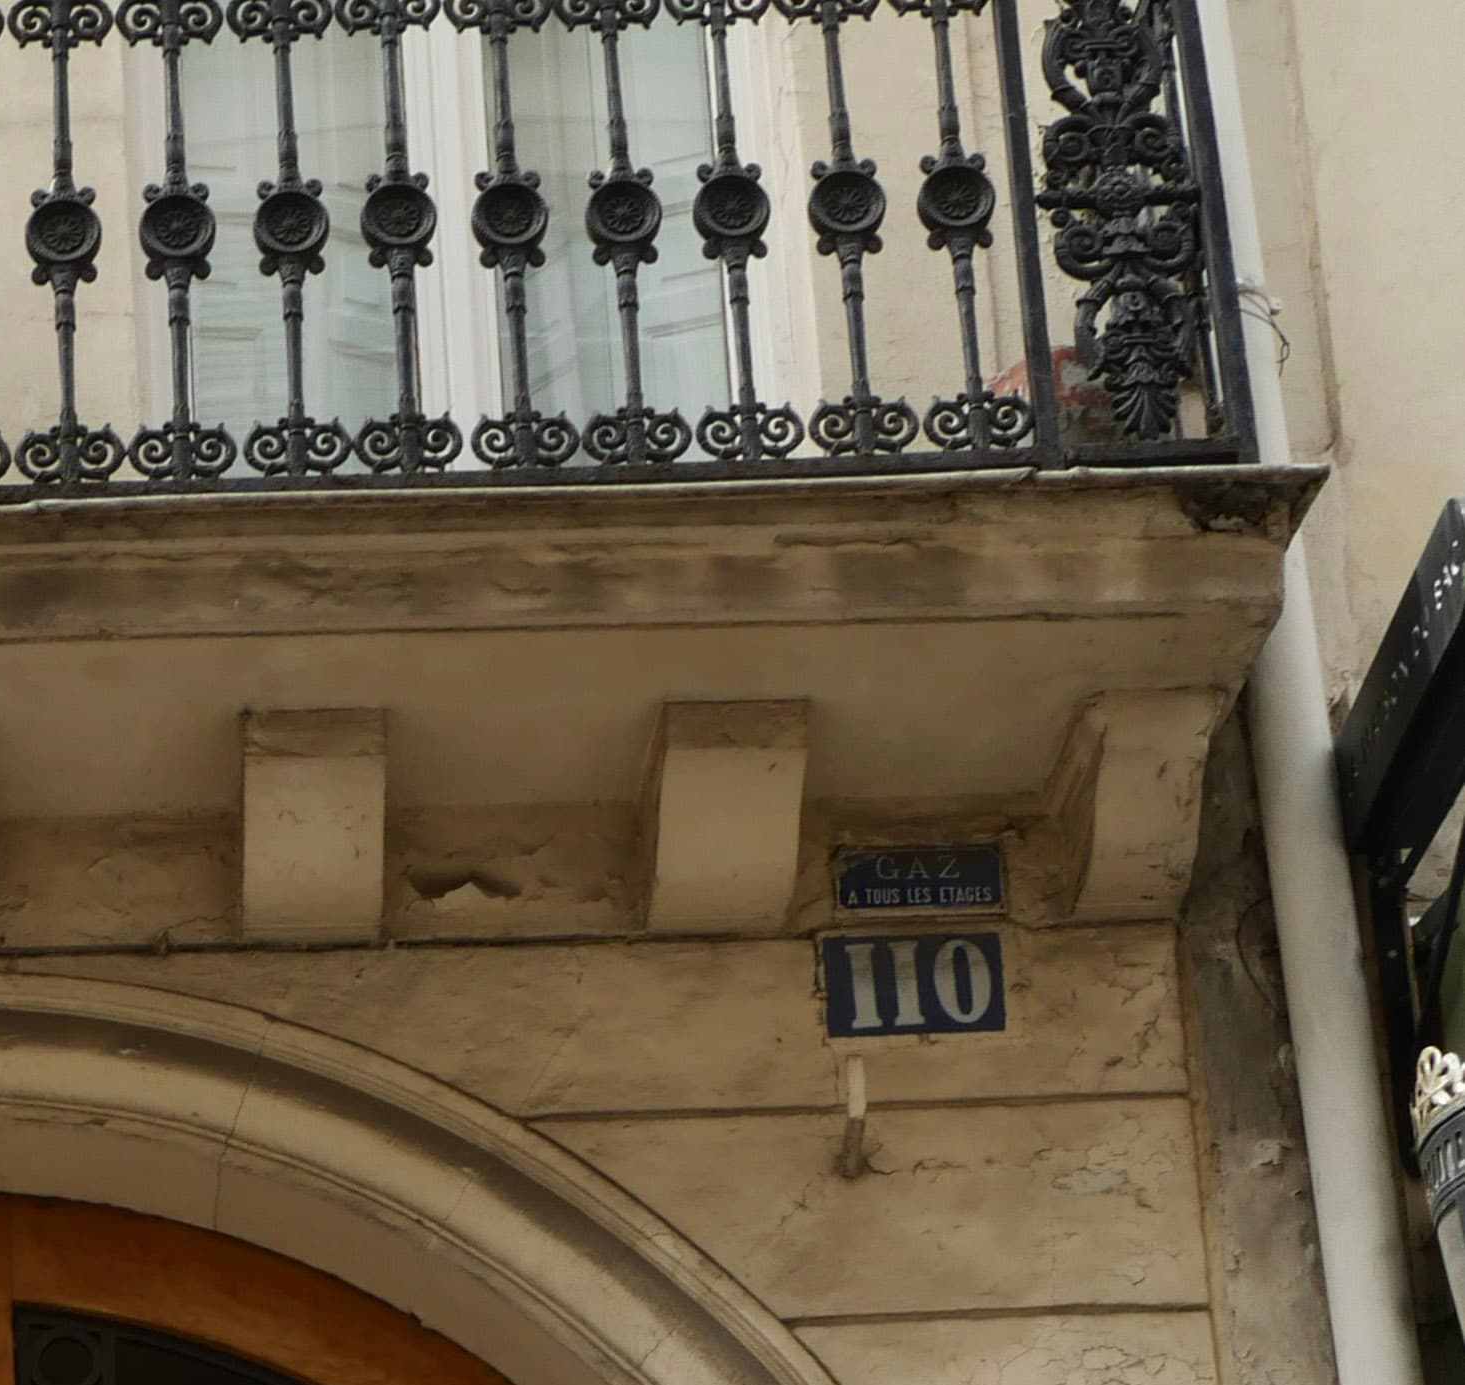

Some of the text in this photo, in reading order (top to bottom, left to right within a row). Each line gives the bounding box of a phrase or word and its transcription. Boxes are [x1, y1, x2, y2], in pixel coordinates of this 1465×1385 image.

[876, 856, 960, 880] GAZ
[848, 886, 992, 905] A TOUS LES ETAGES
[845, 939, 992, 1029] 110
